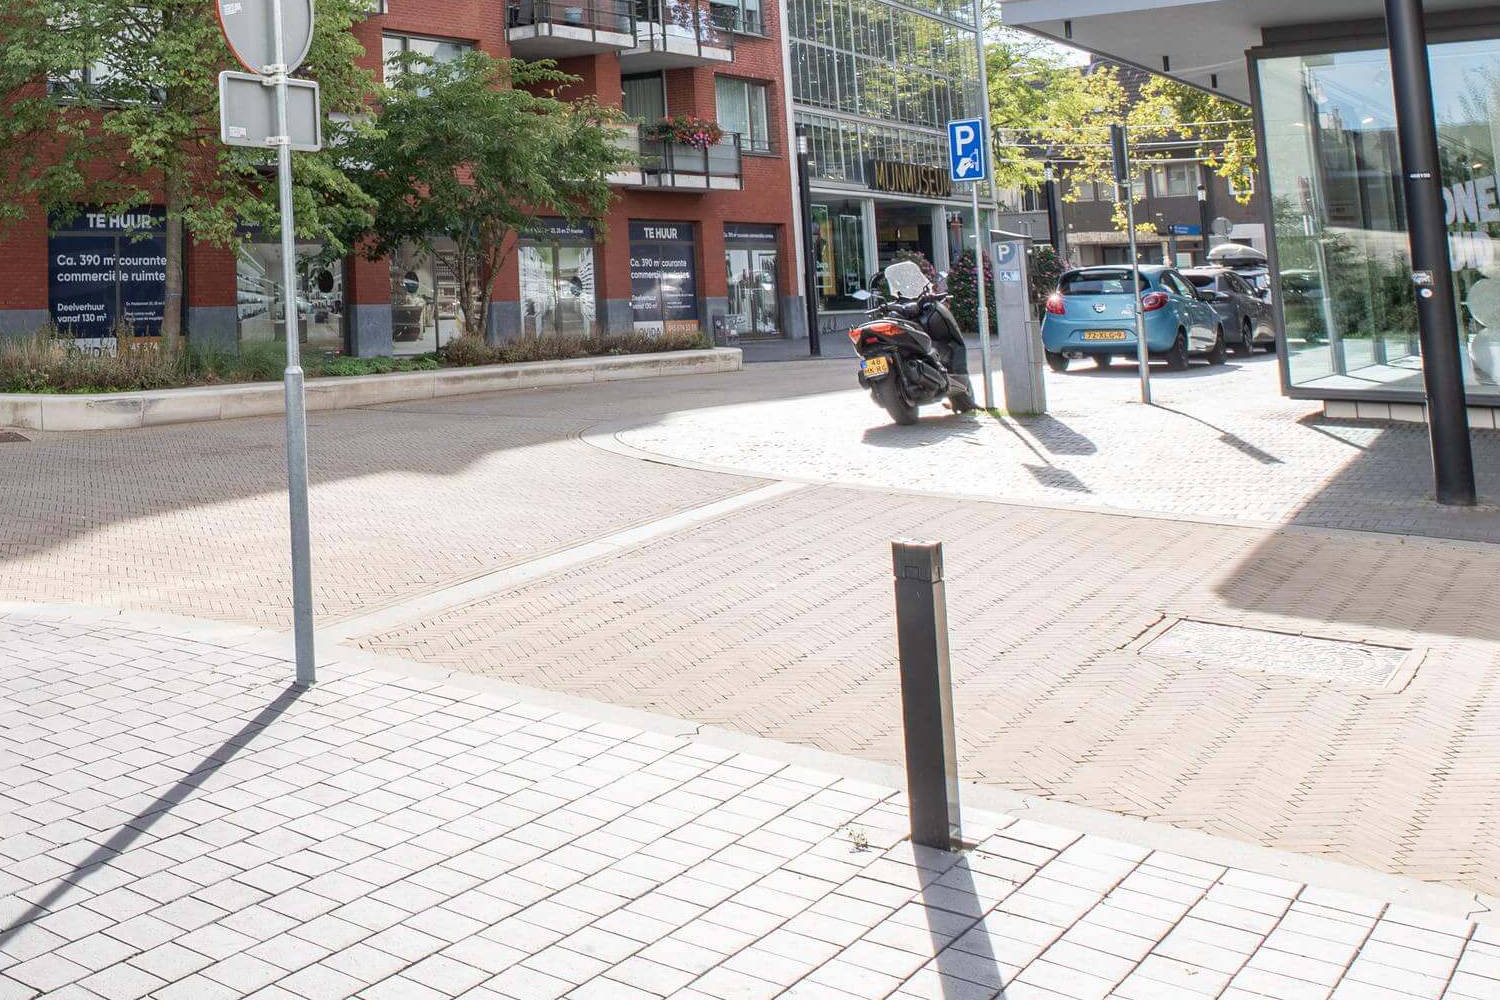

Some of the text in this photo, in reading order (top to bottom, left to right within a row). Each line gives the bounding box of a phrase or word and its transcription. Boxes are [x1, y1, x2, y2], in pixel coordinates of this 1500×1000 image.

[955, 125, 974, 156] P
[86, 213, 152, 229] TE HUUR
[644, 227, 678, 239] TE HUUR
[998, 245, 1010, 261] P
[57, 254, 77, 266] Ca.
[80, 254, 100, 266] 390
[119, 255, 167, 266] courante
[641, 258, 653, 267] 390
[661, 259, 687, 267] courante
[57, 303, 105, 312] Deelverhuur
[57, 313, 81, 322] vanaf
[82, 313, 96, 322] 130
